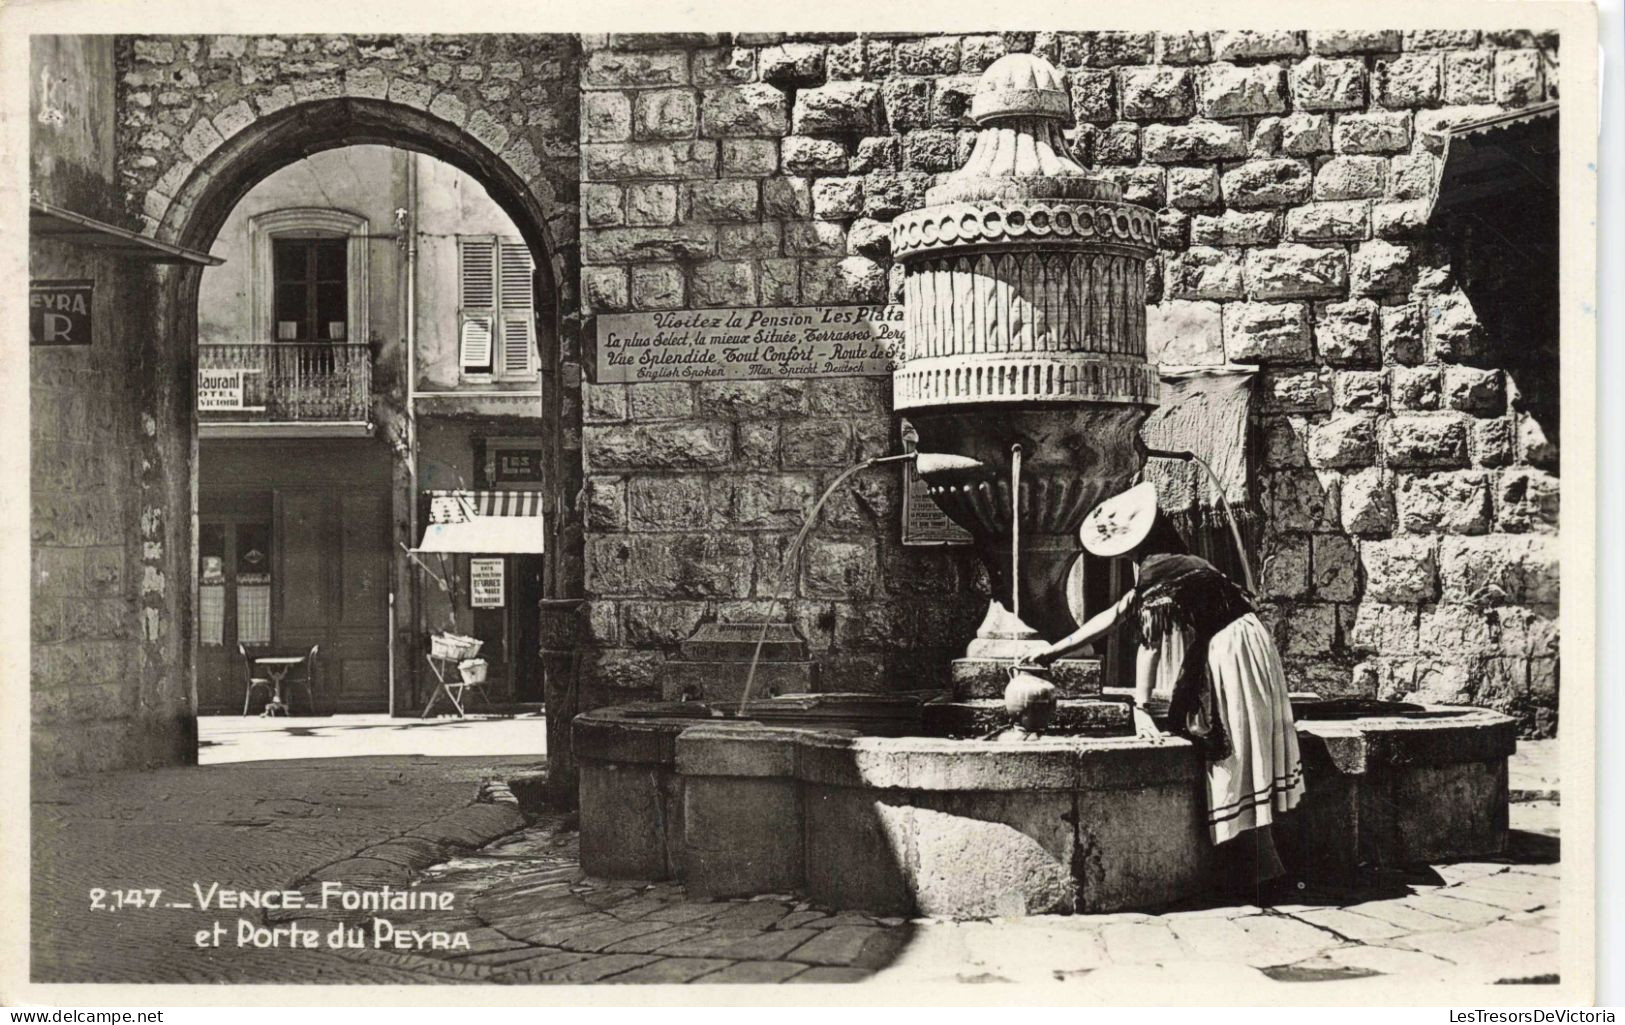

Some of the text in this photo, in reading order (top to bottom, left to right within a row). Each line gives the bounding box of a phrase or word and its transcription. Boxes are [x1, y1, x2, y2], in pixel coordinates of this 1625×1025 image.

[31, 294, 86, 315] EYRA
[653, 312, 723, 328] Visitez
[726, 311, 742, 328] la
[745, 310, 812, 330] Pension
[852, 306, 904, 324] Plata
[604, 333, 620, 348] La
[622, 332, 649, 351] plus
[695, 331, 706, 345] la
[710, 331, 750, 345] mieux
[607, 351, 634, 366] Vue
[723, 347, 759, 363] Tout
[763, 346, 813, 366] Confort
[829, 343, 868, 360] Route
[869, 345, 884, 359] de
[637, 366, 679, 381] English
[682, 365, 725, 379] Spoken
[779, 362, 817, 377] Spricht
[821, 361, 865, 374] Deutsch
